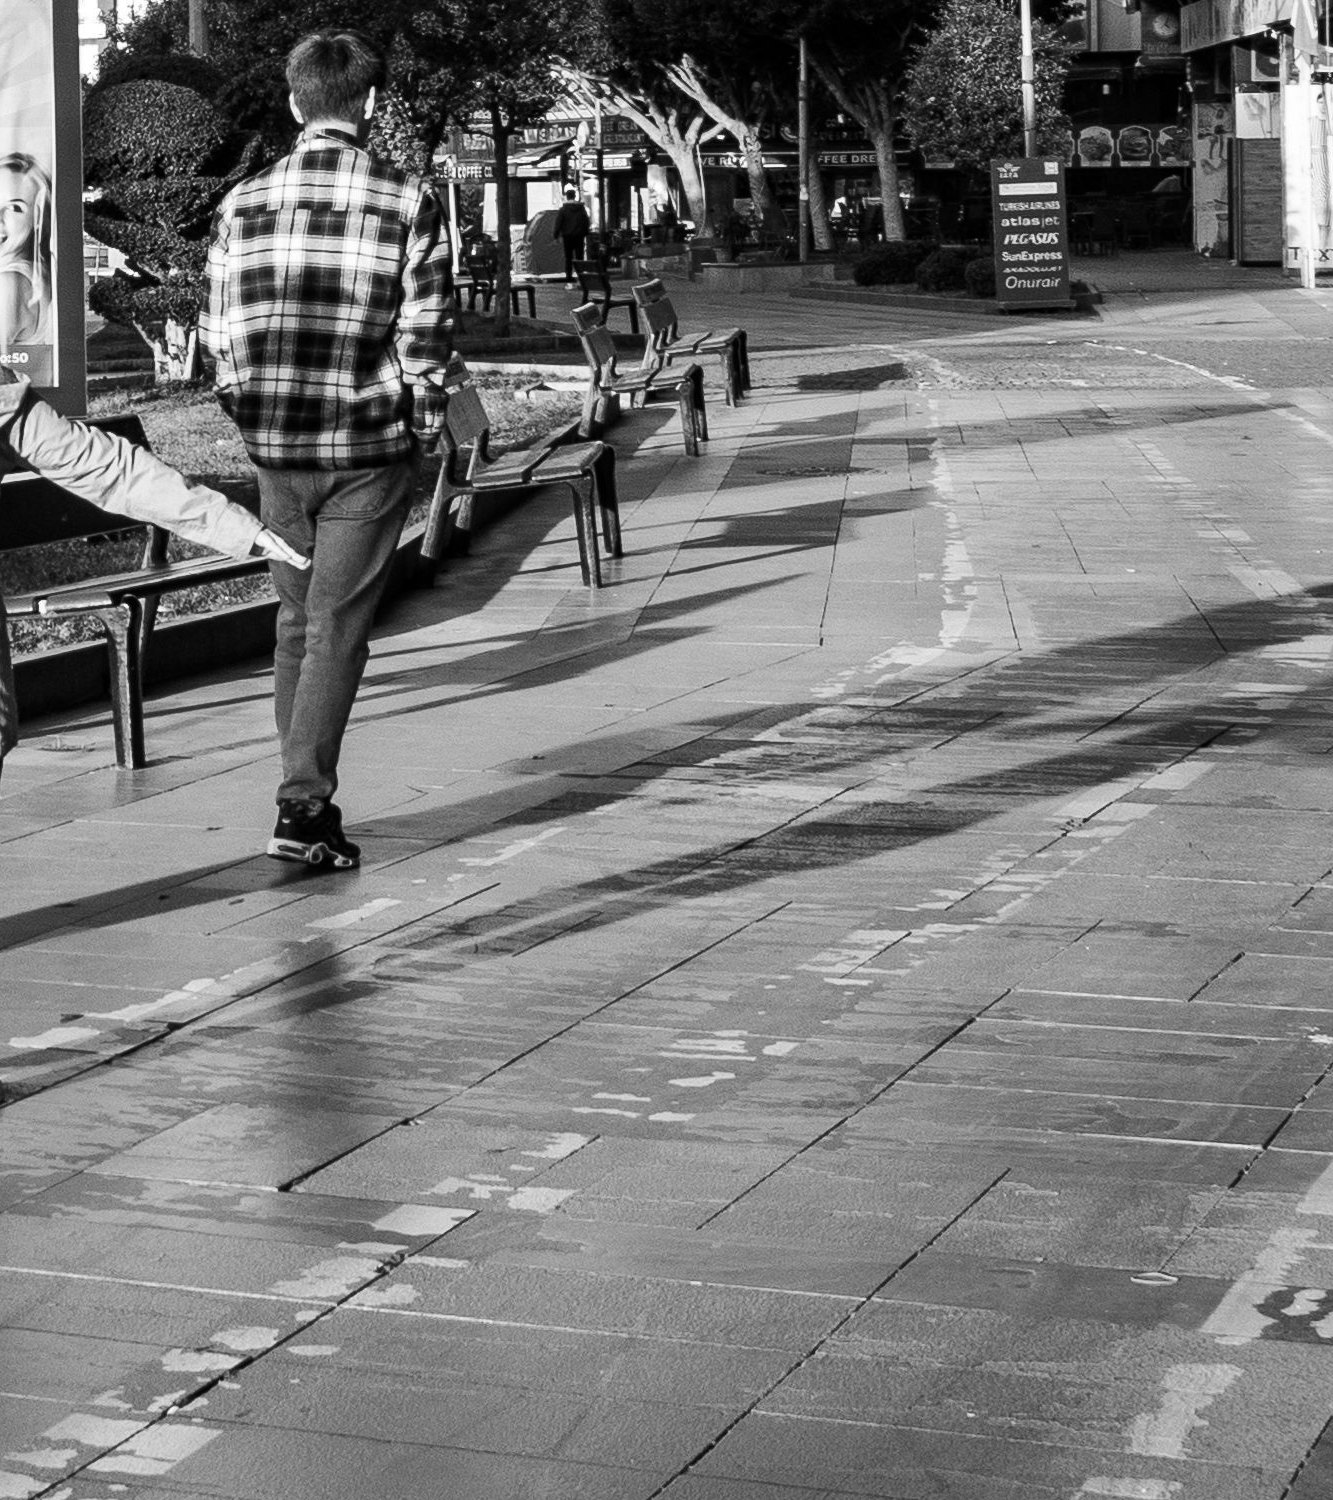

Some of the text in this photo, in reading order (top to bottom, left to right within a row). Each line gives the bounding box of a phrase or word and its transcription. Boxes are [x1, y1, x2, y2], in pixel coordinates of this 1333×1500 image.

[1003, 232, 1060, 245] PEGASUS
[1001, 250, 1063, 263] SunExpress
[1005, 276, 1061, 289] Onurair
